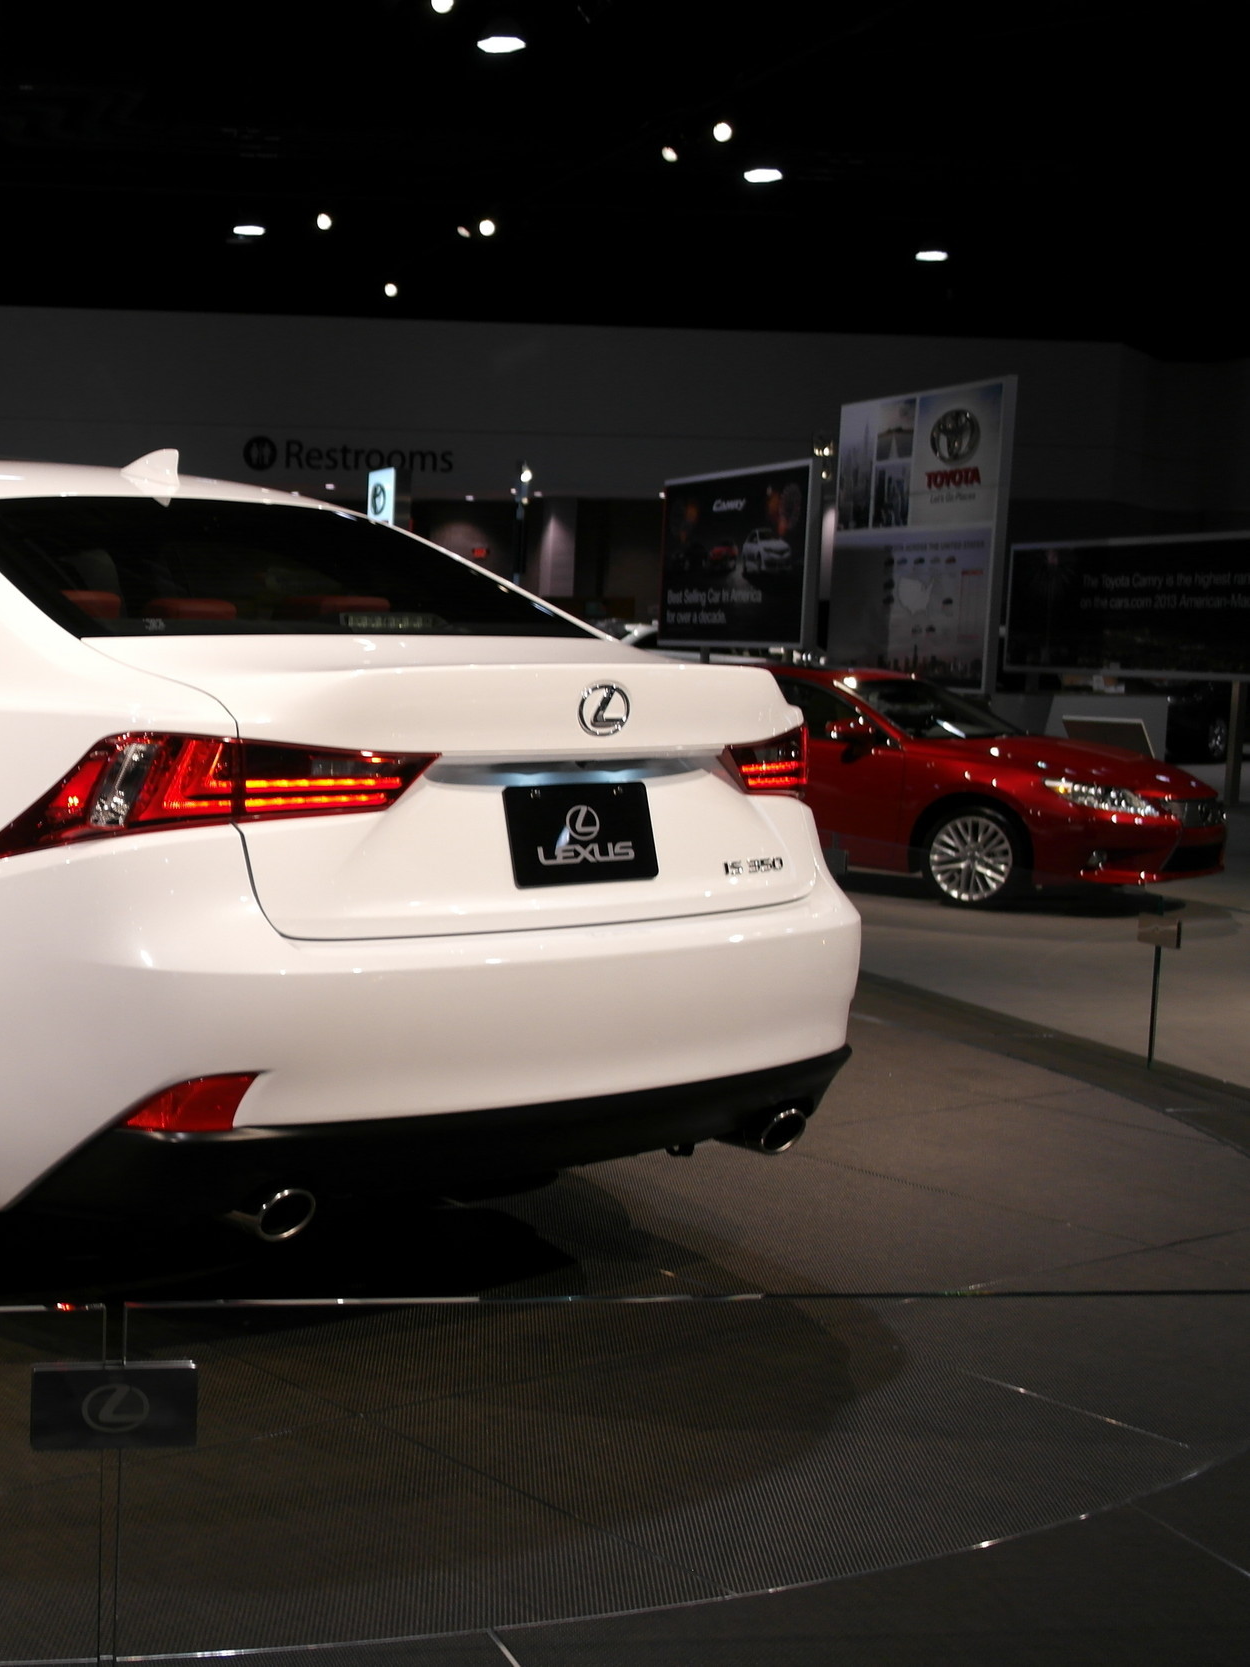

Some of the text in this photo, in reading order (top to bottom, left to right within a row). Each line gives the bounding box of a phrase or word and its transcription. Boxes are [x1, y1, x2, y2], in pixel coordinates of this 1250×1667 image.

[284, 440, 454, 472] Restrooms
[925, 466, 981, 490] TOYOTA
[1083, 573, 1099, 588] The
[1101, 573, 1130, 590] Toyota
[1132, 571, 1163, 590] Camry
[1165, 572, 1174, 588] is
[1176, 571, 1192, 588] the
[1194, 570, 1231, 590] highest
[707, 588, 721, 604] Car
[1080, 597, 1092, 609] on
[1093, 595, 1108, 609] the
[1109, 596, 1152, 609] cars.com
[1153, 594, 1177, 609] 2013
[536, 840, 636, 867] LEXUS
[724, 857, 784, 876] IS 350
